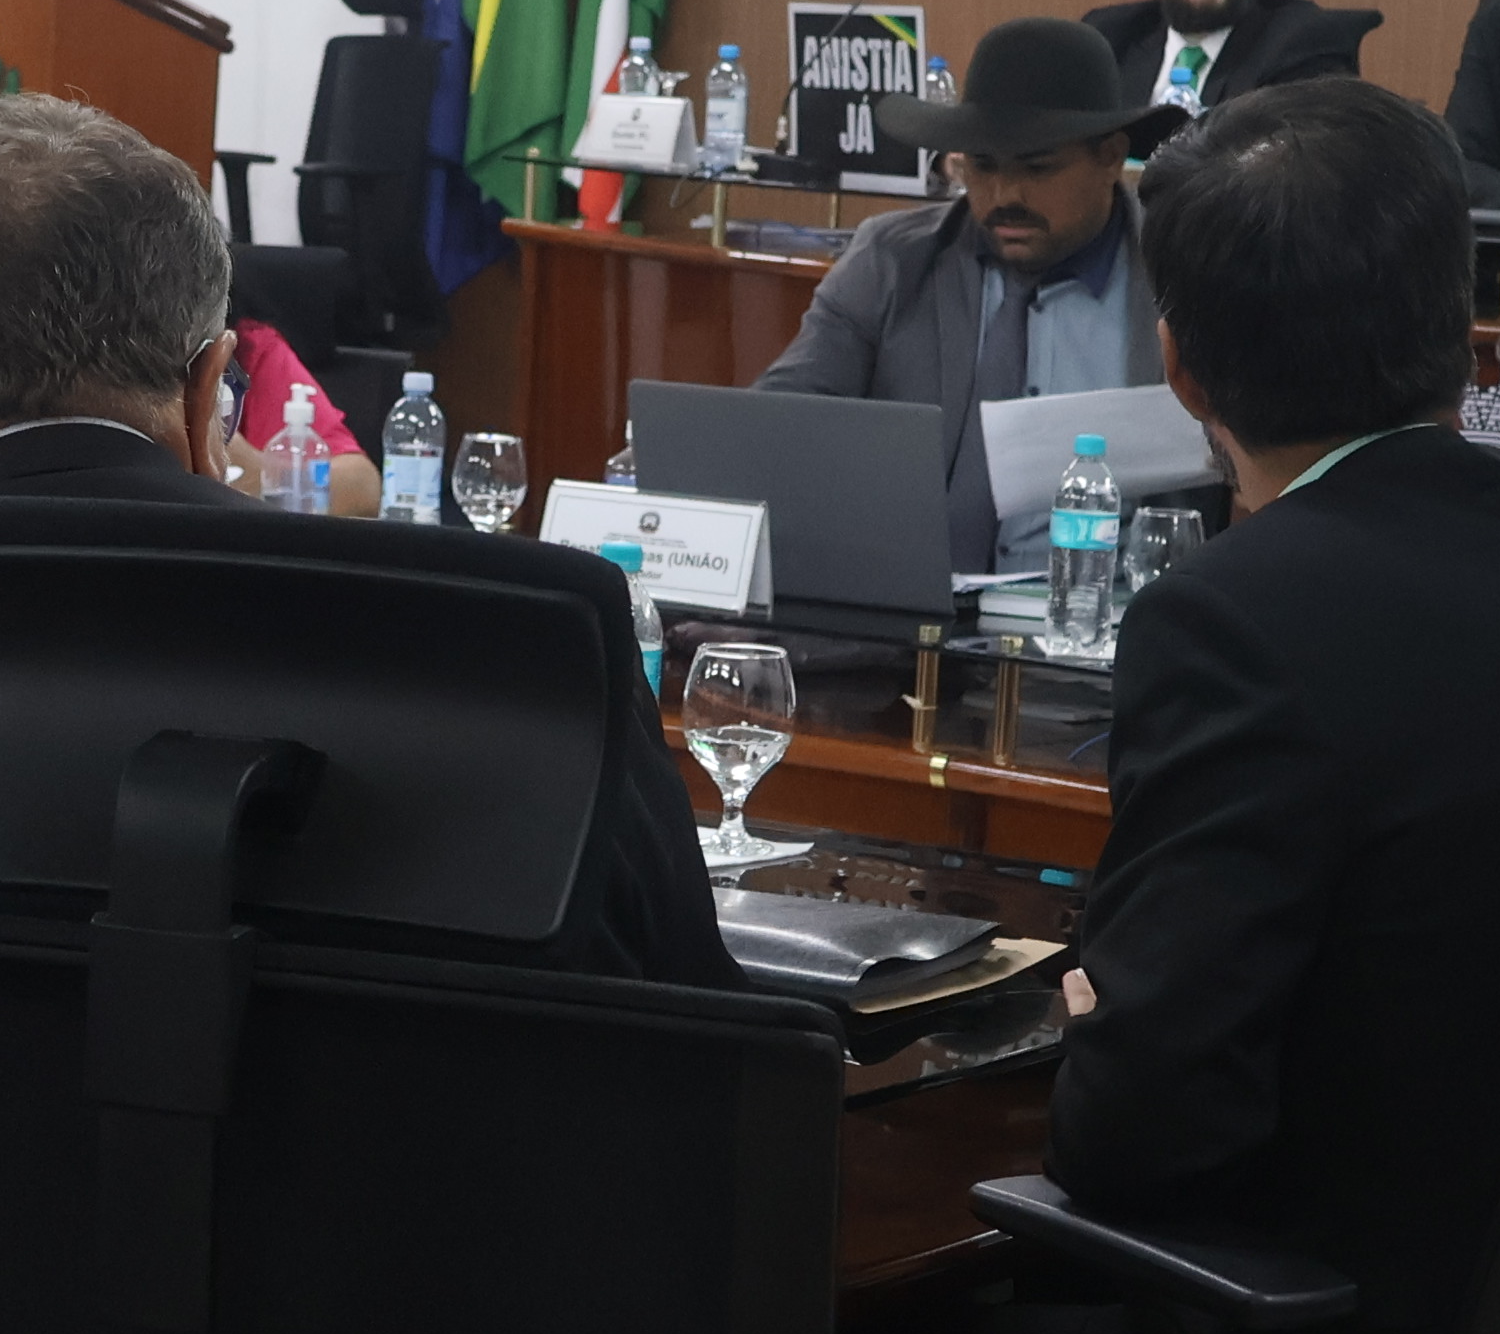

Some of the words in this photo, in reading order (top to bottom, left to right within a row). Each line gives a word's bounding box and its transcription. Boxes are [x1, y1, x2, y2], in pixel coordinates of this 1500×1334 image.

[802, 35, 914, 92] ANISTIA
[839, 94, 874, 154] JÁ
[668, 552, 729, 574] (UNIÃO)
